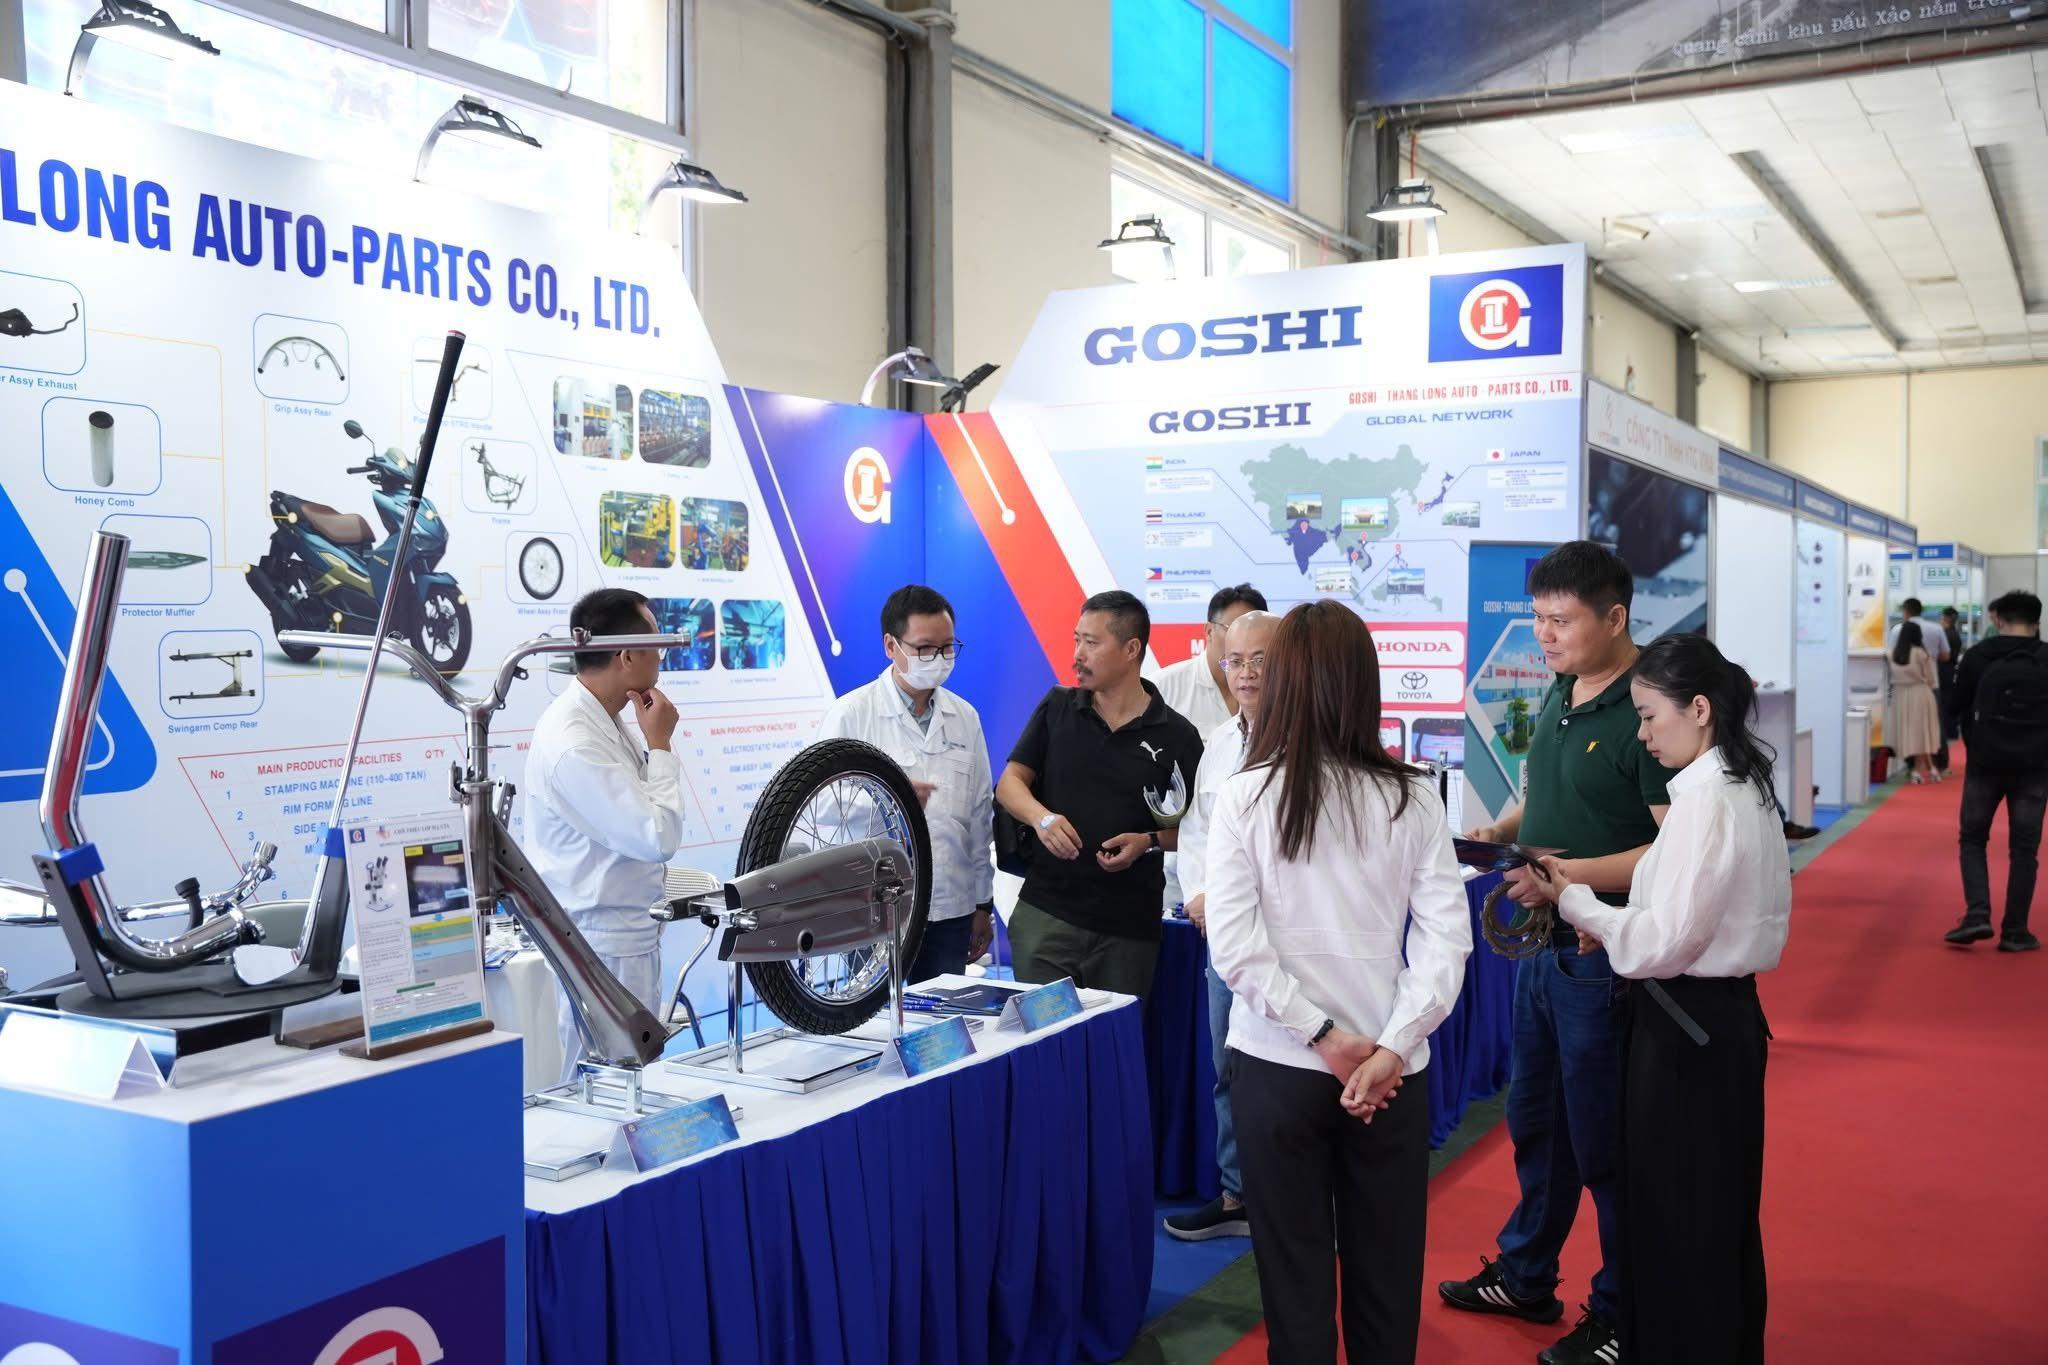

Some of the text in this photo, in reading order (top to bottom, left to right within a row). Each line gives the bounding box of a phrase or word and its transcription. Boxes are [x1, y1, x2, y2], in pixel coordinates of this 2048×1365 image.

[1787, 23, 1824, 40] khu
[1875, 6, 1912, 27] Xảo
[0, 149, 661, 338] LONG AUTO-PARTS CO., LTD.
[1084, 305, 1363, 366] GOSHI
[9, 375, 34, 388] Assy
[37, 378, 78, 391] Exhaust
[1349, 379, 1573, 405] GOSHI THANG LONG AUTO PARTS CO., LTD.
[274, 404, 332, 417] Grip Assy Rear
[1148, 402, 1312, 434] GOSHI
[1366, 409, 1513, 426] GLOBAL NETWORK
[1510, 450, 1541, 458] JAPAN
[75, 496, 135, 507] Honey Comb
[122, 608, 195, 617] Protector Muffler
[1377, 642, 1453, 652] HONDA
[1397, 691, 1432, 700] TOYOTA
[168, 720, 258, 733] Swingarm Comp Rear
[210, 770, 224, 780] No
[258, 765, 283, 775] MAIN
[286, 757, 344, 772] PRODUCTIO
[353, 753, 401, 766] FACILITIES
[226, 791, 231, 800] 1
[264, 781, 317, 796] STAMPING
[320, 775, 364, 791] MACINE
[406, 770, 427, 782] TAN)
[237, 796, 372, 820] 2 RIM FORMG LINE
[248, 832, 254, 841] 3
[294, 824, 316, 835] SIDE
[282, 891, 287, 899] 6
